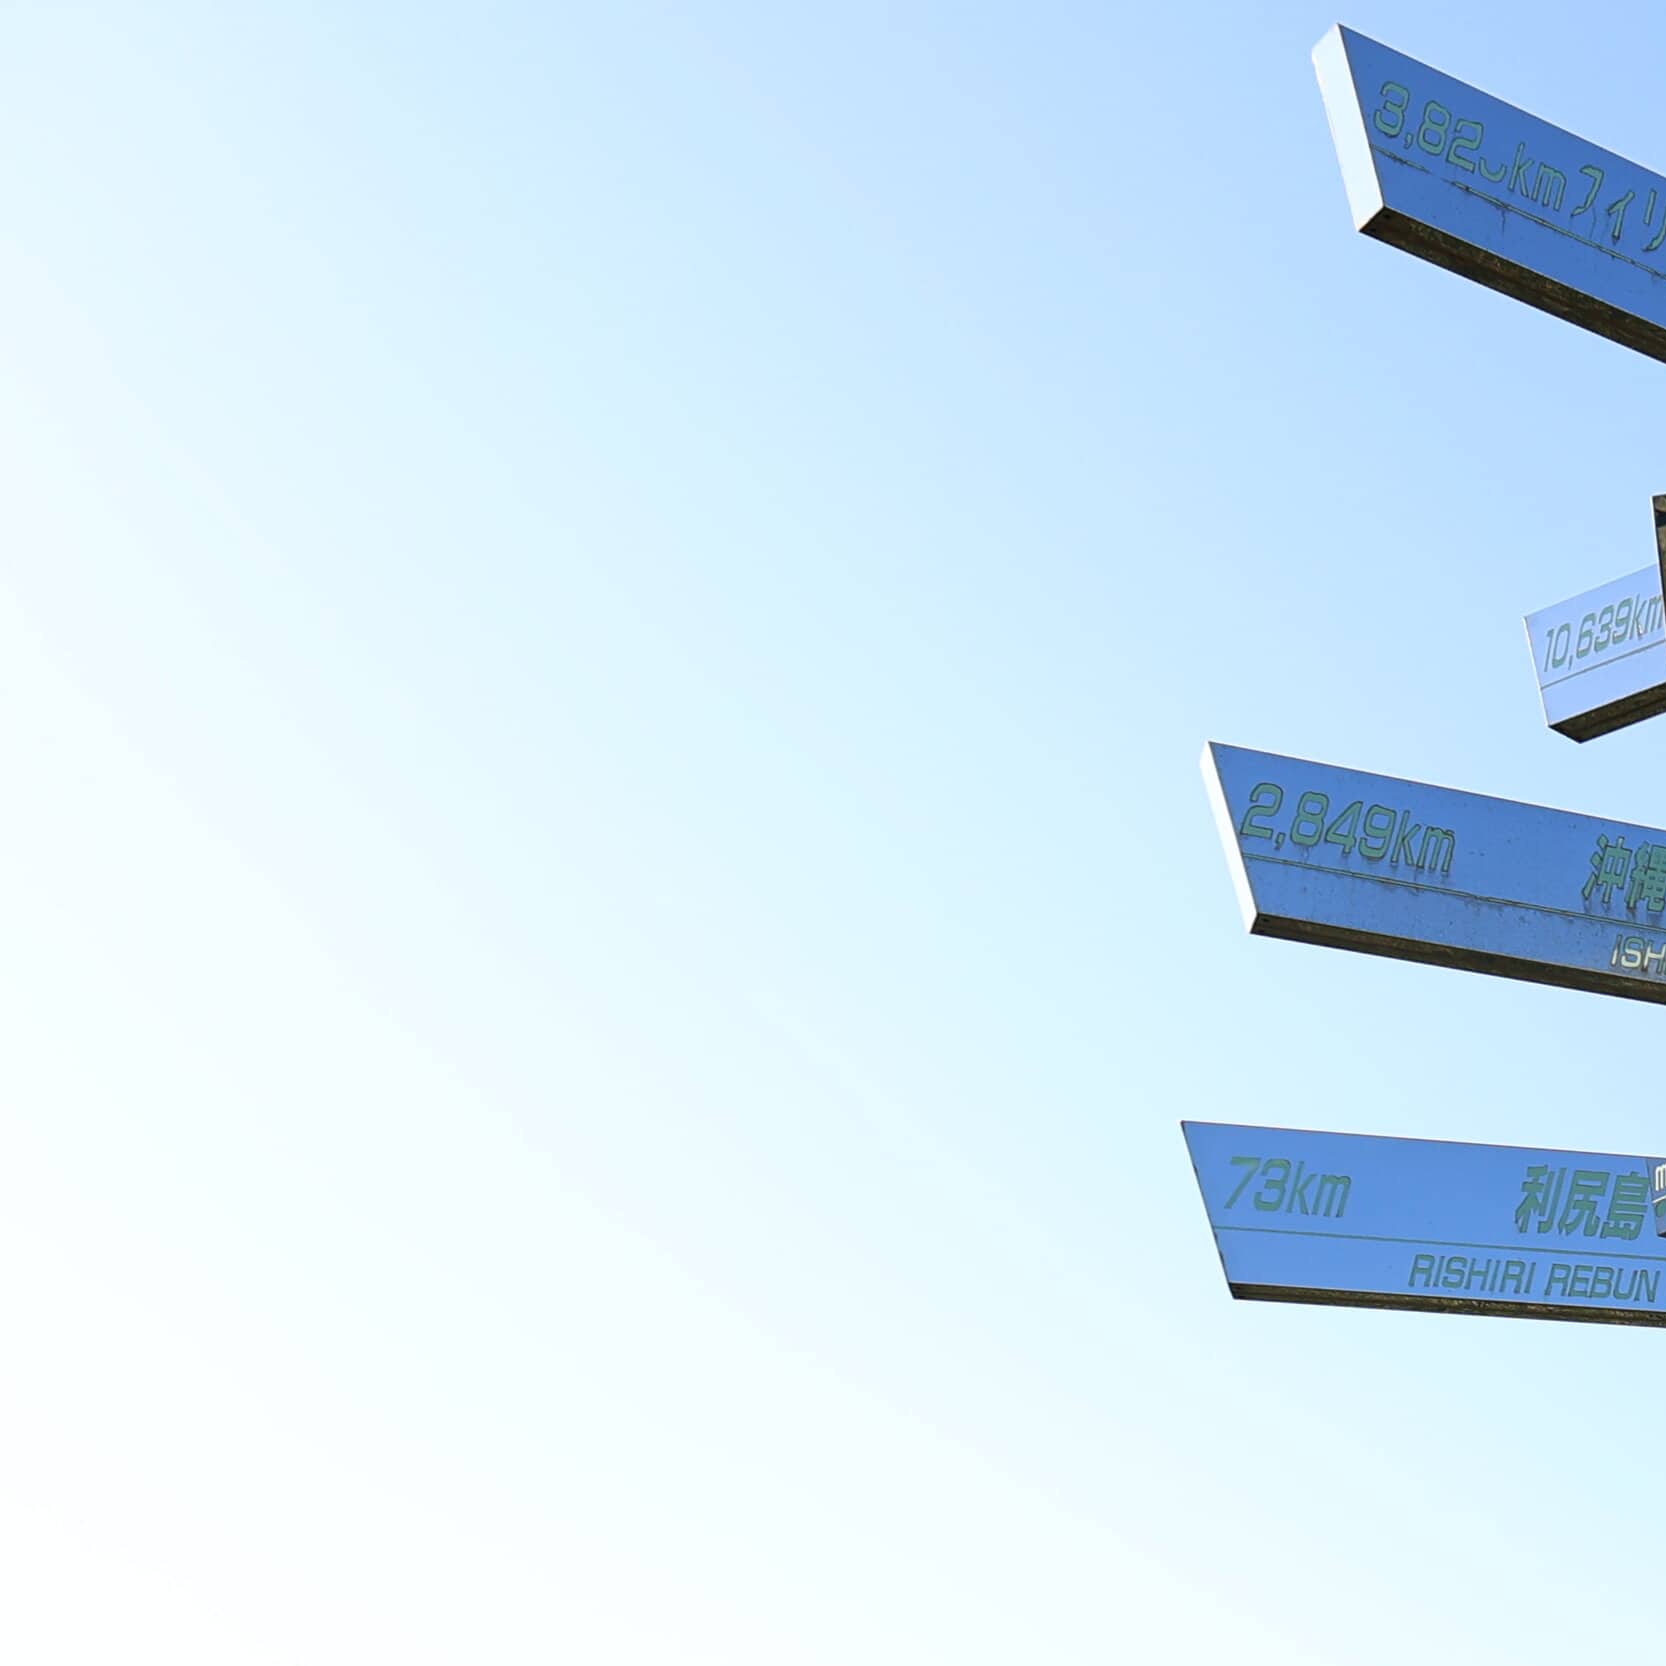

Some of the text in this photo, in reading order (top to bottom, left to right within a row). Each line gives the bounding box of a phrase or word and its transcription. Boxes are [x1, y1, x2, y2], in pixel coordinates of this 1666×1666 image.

[1240, 782, 1456, 874] 2,849km
[1222, 1155, 1352, 1218] 73km
[1407, 1253, 1532, 1296] RISHIRI
[1544, 1262, 1658, 1303] REBUN
